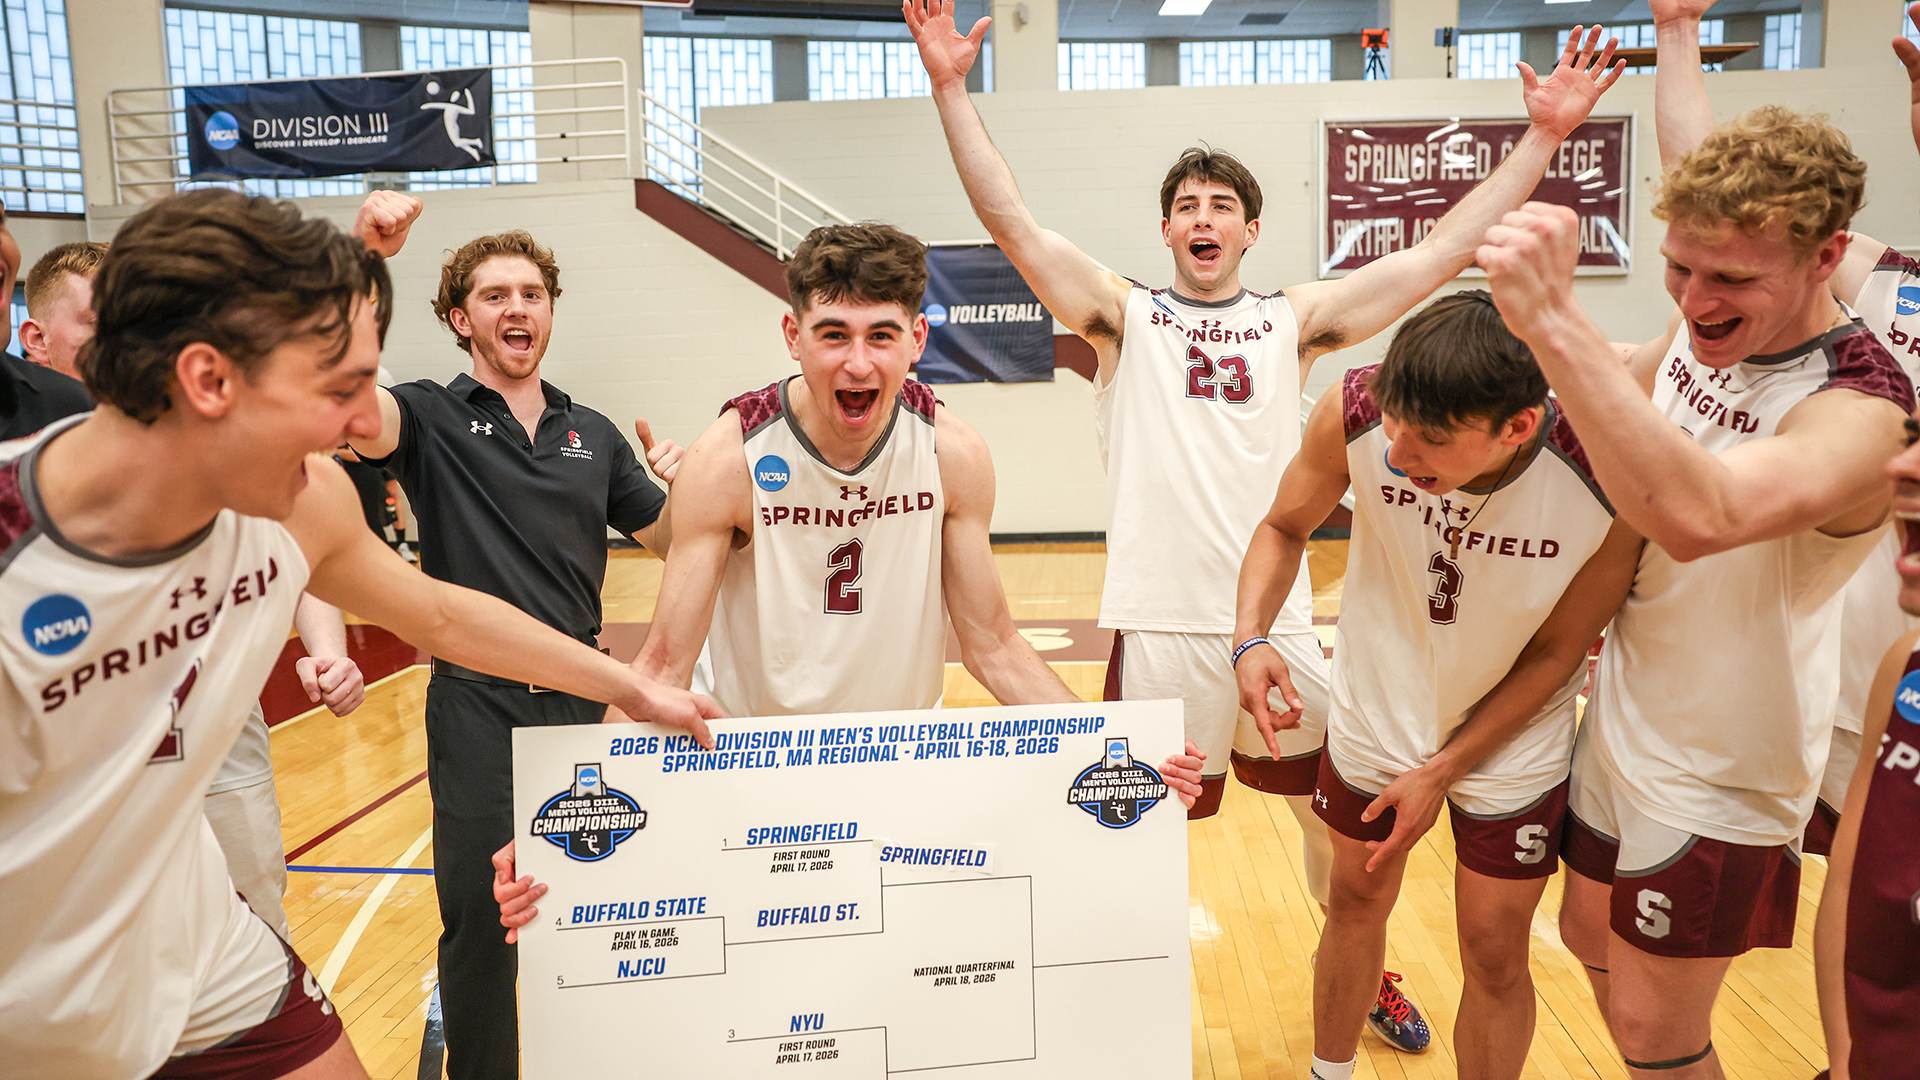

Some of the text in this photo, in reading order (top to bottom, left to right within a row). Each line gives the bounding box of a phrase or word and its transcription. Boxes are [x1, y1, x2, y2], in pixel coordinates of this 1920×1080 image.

[253, 112, 389, 139] DIVISION III
[254, 135, 388, 149] DISCOVER DEVELOP DEDICATE
[1501, 139, 1605, 179] LEGE
[950, 303, 1044, 324] VOLLEYBALL
[1186, 343, 1255, 404] 23
[759, 471, 787, 483] NCAA
[761, 491, 935, 527] SPRINGFIELD
[824, 537, 863, 615] 2
[1428, 551, 1464, 625] 3
[33, 615, 90, 647] NCAA
[610, 736, 659, 756] 2026
[715, 730, 792, 751] DIVISION
[797, 729, 815, 747] III
[820, 727, 873, 746] MEN'S
[879, 722, 975, 743] VOLLEYBALL
[980, 716, 1105, 739] CHAMPIONSHIP
[662, 750, 780, 773] SPRINGFIELD,
[786, 749, 813, 767] MA
[818, 743, 899, 764] REGIONAL
[914, 741, 961, 760] APRIL
[966, 739, 1009, 758] 16-18,
[1015, 737, 1059, 755] 2026
[1082, 776, 1154, 787] MEN'S VOLLEYBALL
[1092, 769, 1144, 779] 2026 DIII
[558, 797, 619, 809] 2026 DIII
[1069, 784, 1167, 803] CHAMPIONSHIP
[547, 805, 630, 817] MEN'S VOLLEYBALL
[533, 812, 646, 834] CHAMPIONSHIP
[746, 821, 858, 846] SPRINGFIELD
[1514, 823, 1550, 864] S
[773, 849, 830, 861] FIRST ROUND
[880, 845, 987, 867] SPRINGFIELD
[770, 860, 834, 873] APRIL 17, 2026
[571, 896, 707, 924] BUFFALO STATE
[757, 902, 860, 927] BUFFALO ST.
[1635, 888, 1673, 939] S
[555, 917, 562, 926] 4
[610, 937, 679, 951] APRIL 16, 2026
[614, 927, 676, 941] PLAY IN GAME
[617, 957, 666, 978] NJCU
[913, 960, 1015, 977] NATIONAL QUARTERFINAL
[556, 975, 564, 985] 5
[933, 973, 996, 987] APRIL 18, 2026
[790, 1013, 824, 1033] NYU
[728, 1029, 735, 1038] 3
[778, 1038, 836, 1052] FIRST ROUND
[776, 1050, 839, 1065] APRIL 17, 2026
